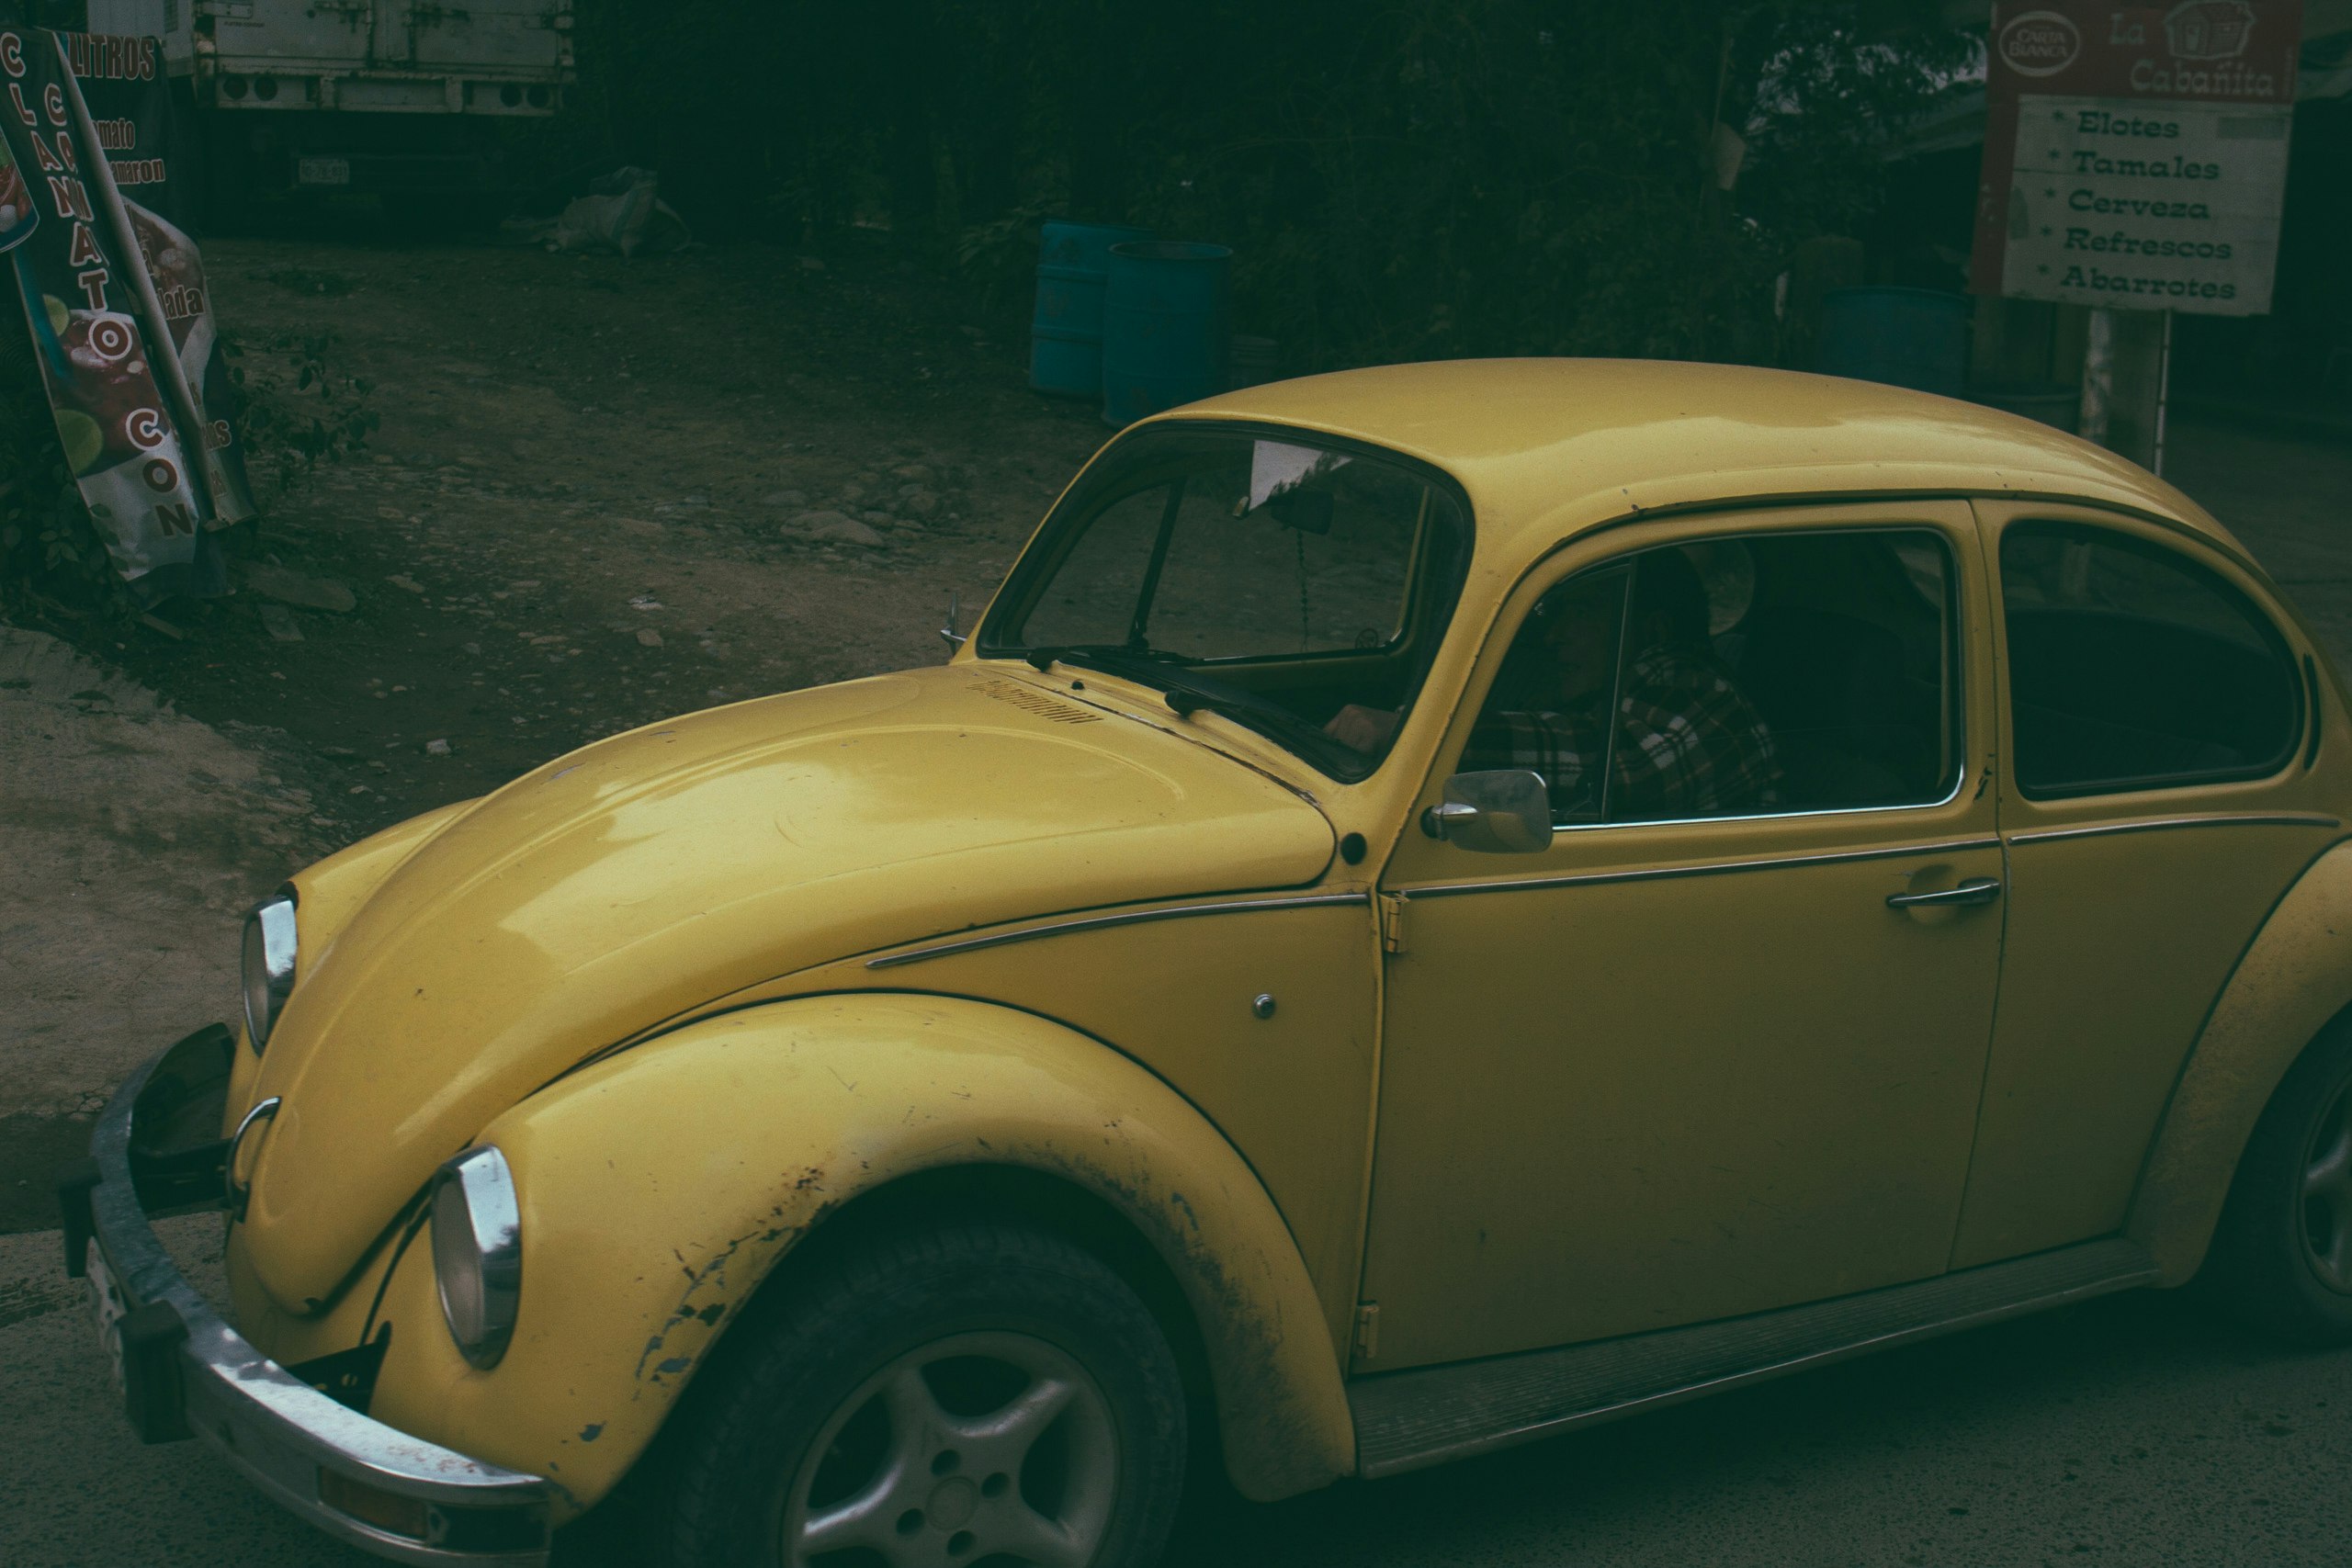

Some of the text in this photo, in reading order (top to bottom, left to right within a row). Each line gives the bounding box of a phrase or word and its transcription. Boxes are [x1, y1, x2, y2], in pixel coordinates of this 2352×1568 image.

[2016, 27, 2066, 44] CARTA
[2109, 12, 2146, 46] La
[67, 32, 157, 82] LITROS
[2008, 40, 2067, 58] BLANCA
[2130, 58, 2275, 96] Cabañita
[2077, 111, 2179, 139] Elotes
[2073, 151, 2221, 180] Tamales
[2068, 189, 2211, 220] Cerveza
[2064, 227, 2233, 260] Refrescos
[2060, 265, 2237, 300] Abarrotes
[125, 408, 194, 537] CON
